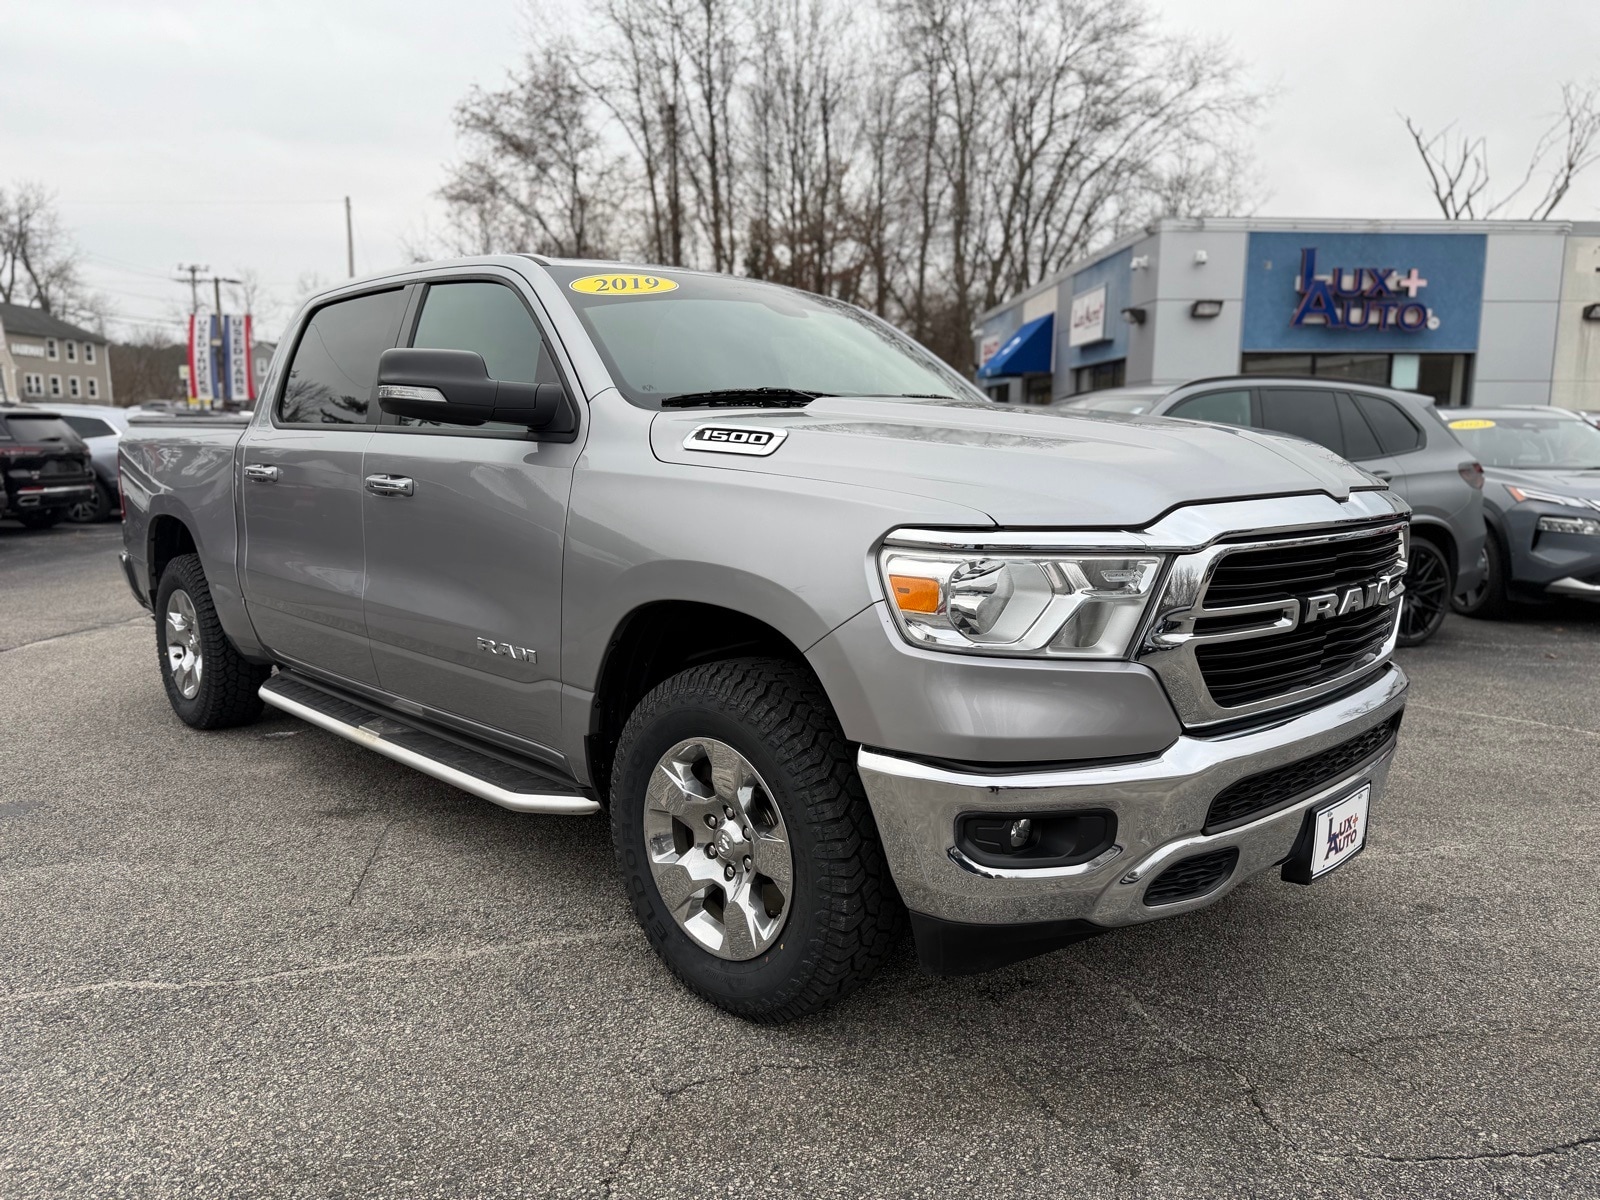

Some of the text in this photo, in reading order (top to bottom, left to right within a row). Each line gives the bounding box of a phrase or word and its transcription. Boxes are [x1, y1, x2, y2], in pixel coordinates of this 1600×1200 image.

[593, 277, 660, 292] 2019
[232, 318, 245, 394] USED CARS
[702, 429, 769, 446] 1500
[1304, 579, 1390, 624] RAM
[477, 636, 538, 665] RAM
